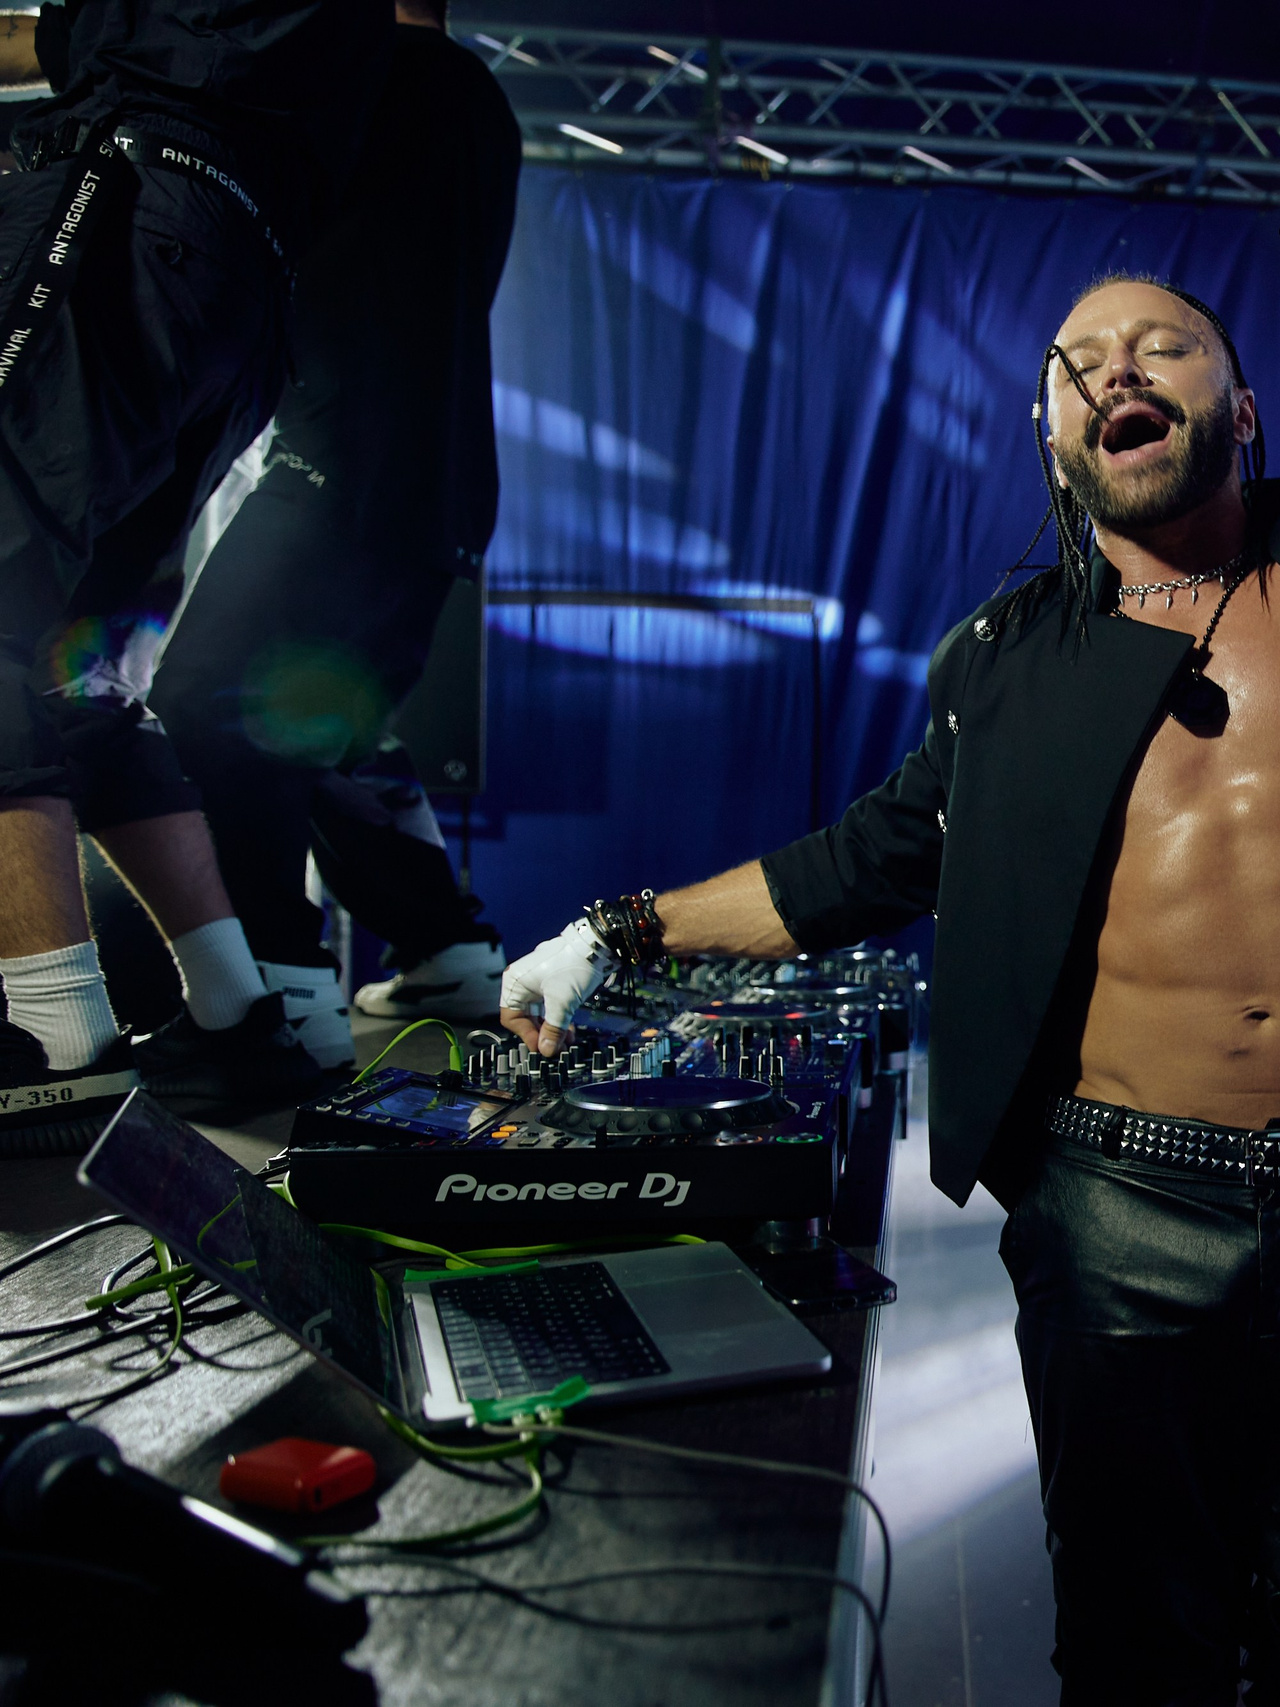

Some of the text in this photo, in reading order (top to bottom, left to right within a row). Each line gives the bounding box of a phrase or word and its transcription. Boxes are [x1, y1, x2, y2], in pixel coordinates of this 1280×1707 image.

[162, 147, 259, 217] ANTAGONIST
[28, 283, 51, 308] KIT
[49, 170, 101, 265] ANTAGONIST
[0, 1087, 73, 1109] Y-350
[435, 1173, 629, 1202] Pioneer
